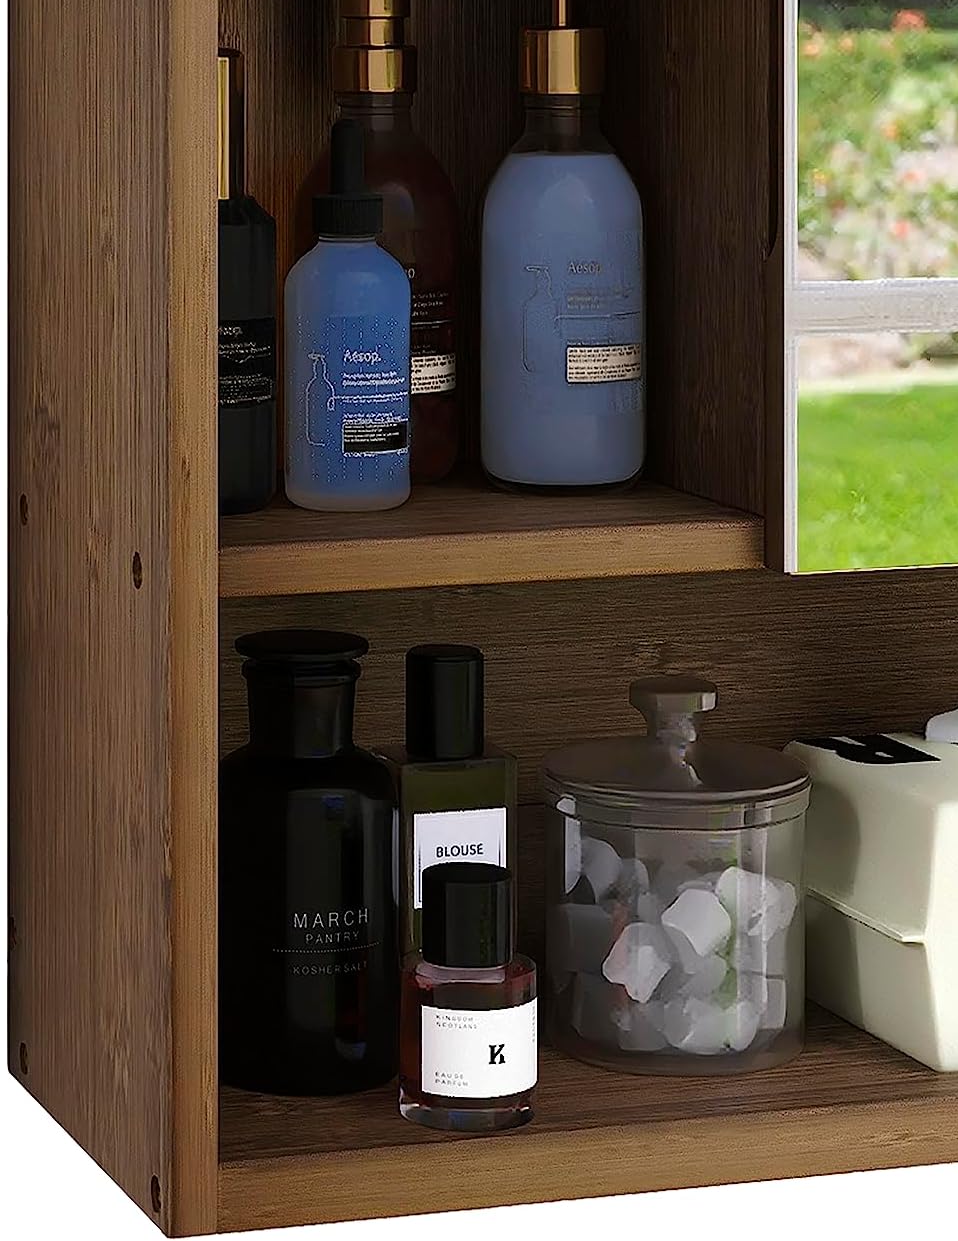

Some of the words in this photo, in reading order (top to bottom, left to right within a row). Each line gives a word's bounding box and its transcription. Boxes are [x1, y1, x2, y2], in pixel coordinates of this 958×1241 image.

[436, 843, 484, 858] BLOUSE
[293, 908, 368, 928] MARCH
[305, 931, 360, 944] PANTRY
[293, 964, 340, 975] KOSHER
[488, 1043, 506, 1064] K
